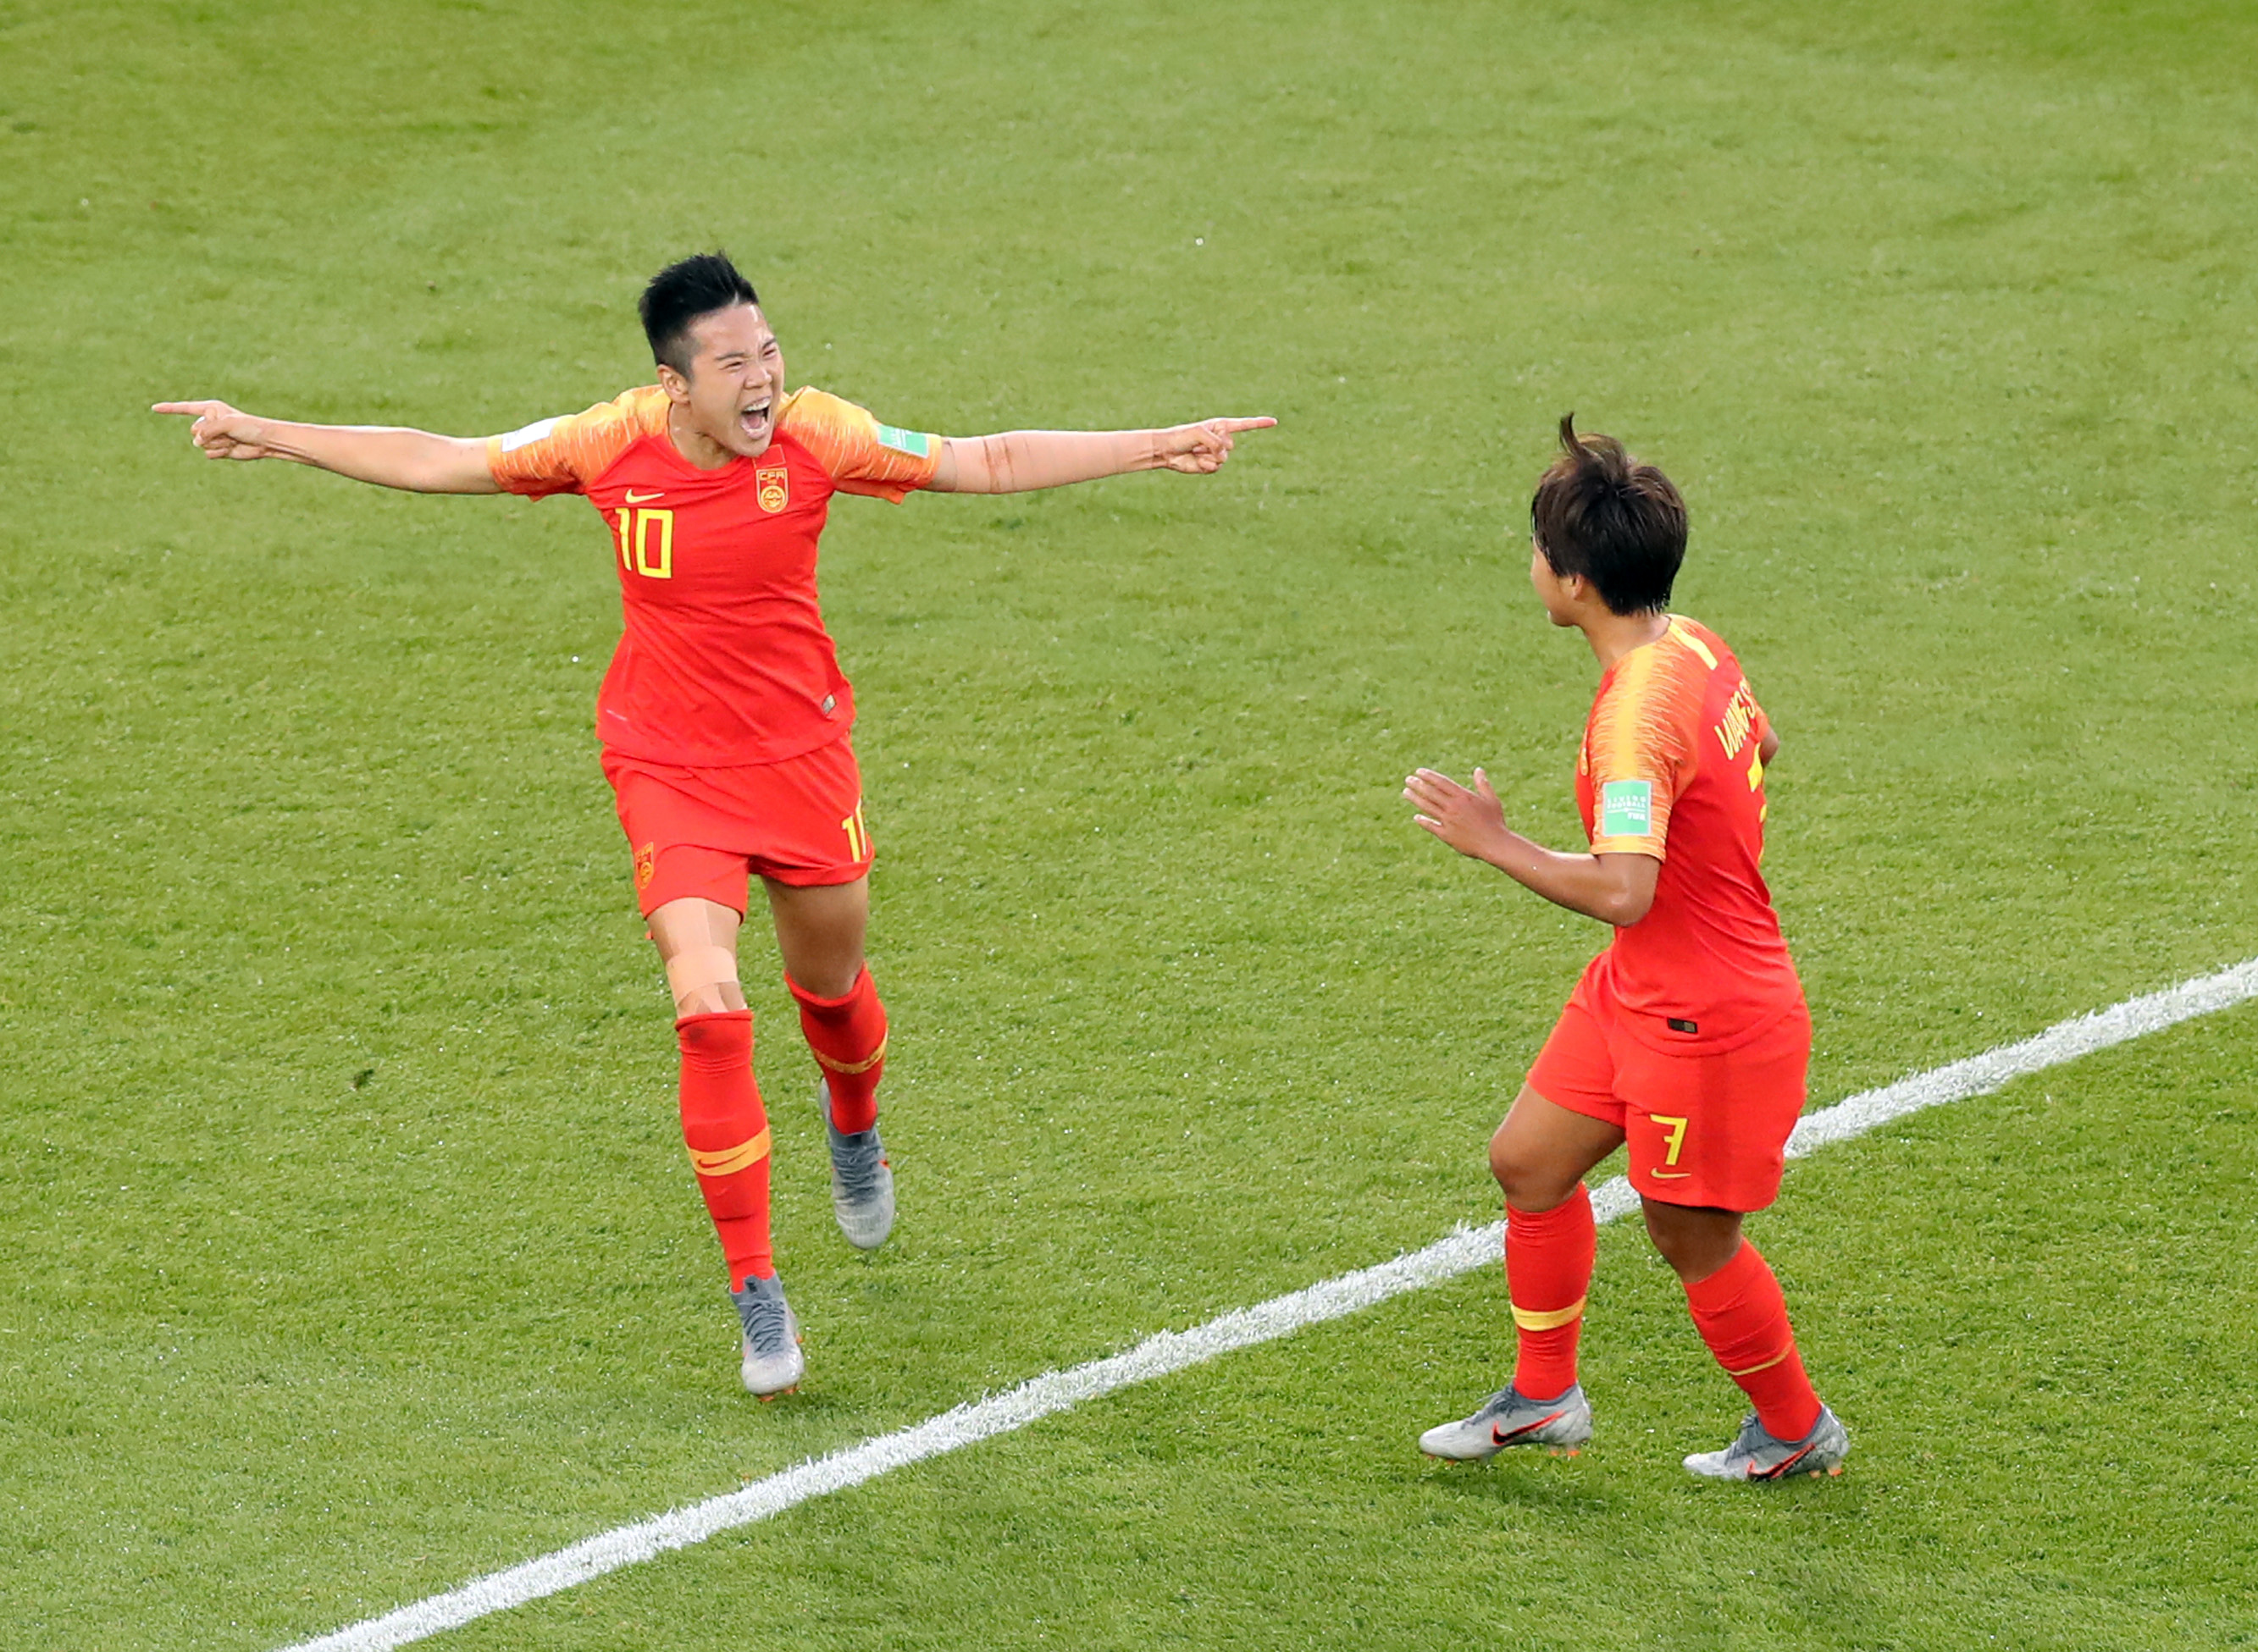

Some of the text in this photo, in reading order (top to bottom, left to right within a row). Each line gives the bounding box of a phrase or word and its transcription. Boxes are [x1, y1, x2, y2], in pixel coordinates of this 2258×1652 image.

[759, 471, 784, 481] CFA
[615, 507, 673, 578] 10
[1650, 1114, 1688, 1165] 7
